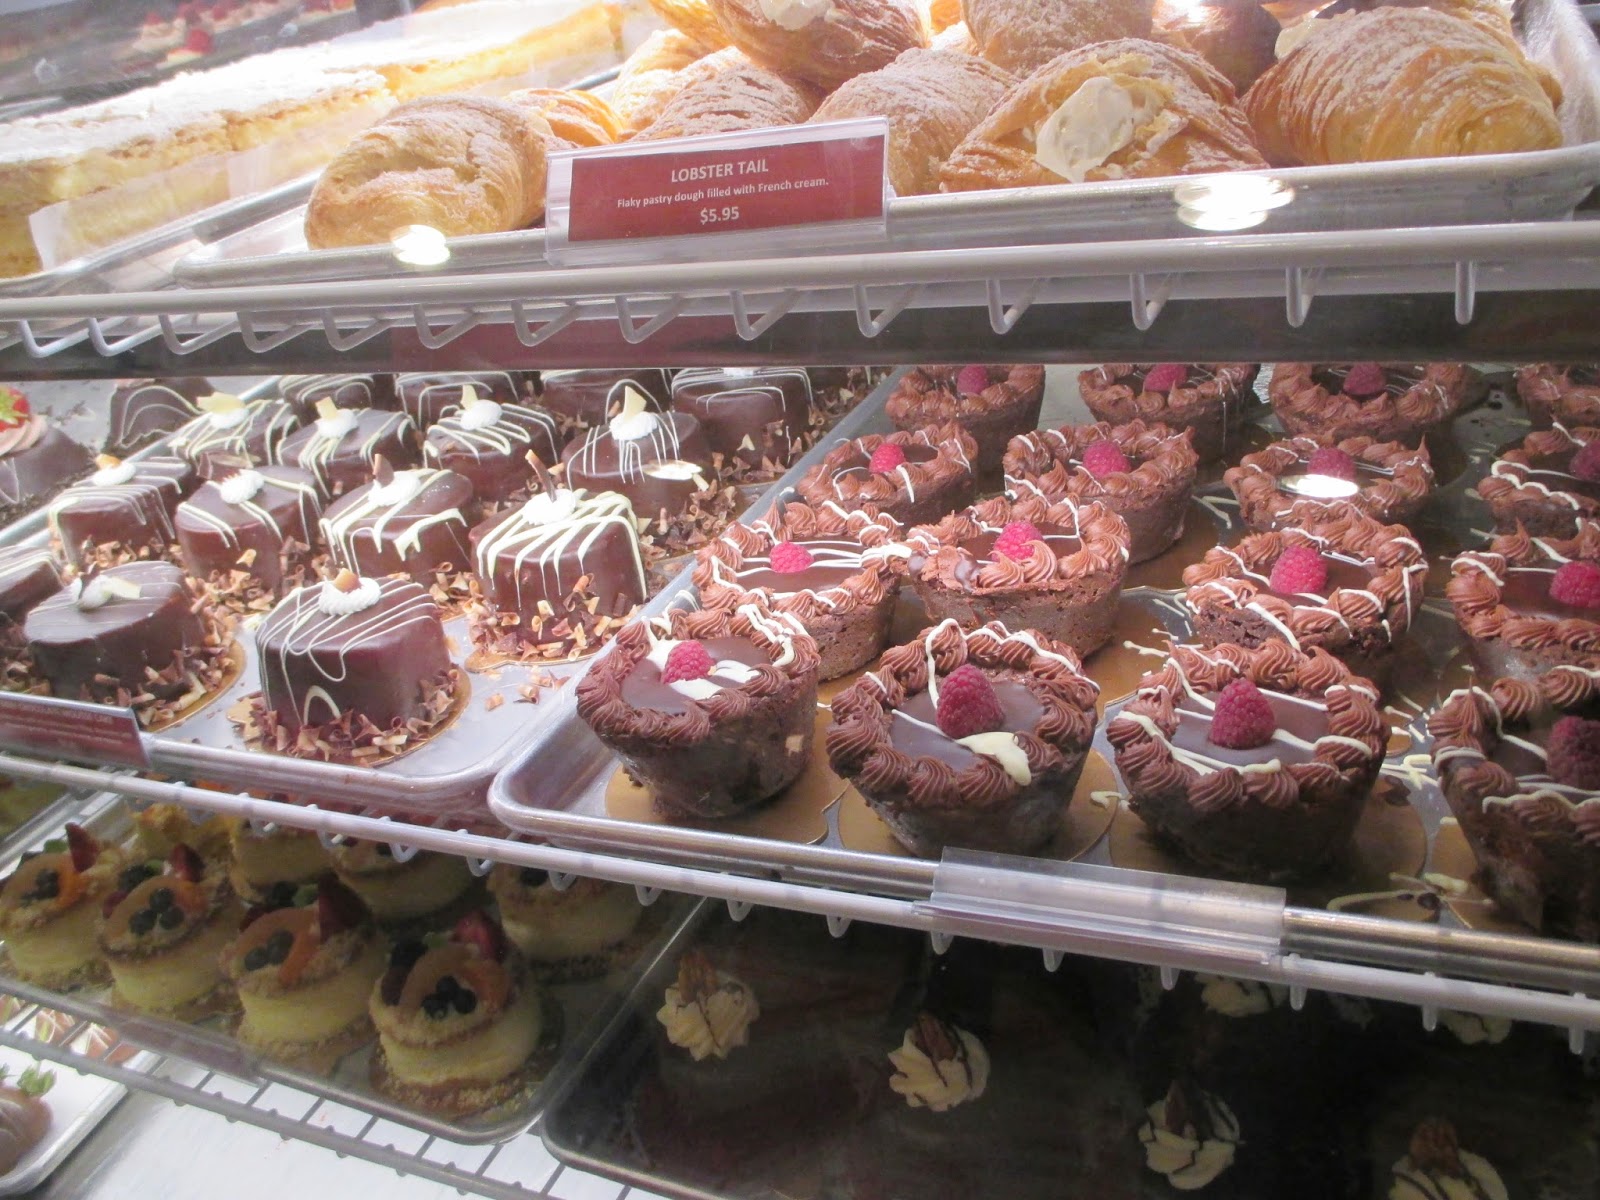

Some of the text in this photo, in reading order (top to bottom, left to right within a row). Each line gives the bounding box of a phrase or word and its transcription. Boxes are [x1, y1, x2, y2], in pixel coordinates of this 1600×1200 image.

[671, 159, 769, 183] LOBSTER TAIL
[617, 178, 829, 209] Flaky pastry dough filled with French cream.
[700, 206, 740, 225] $5.95
